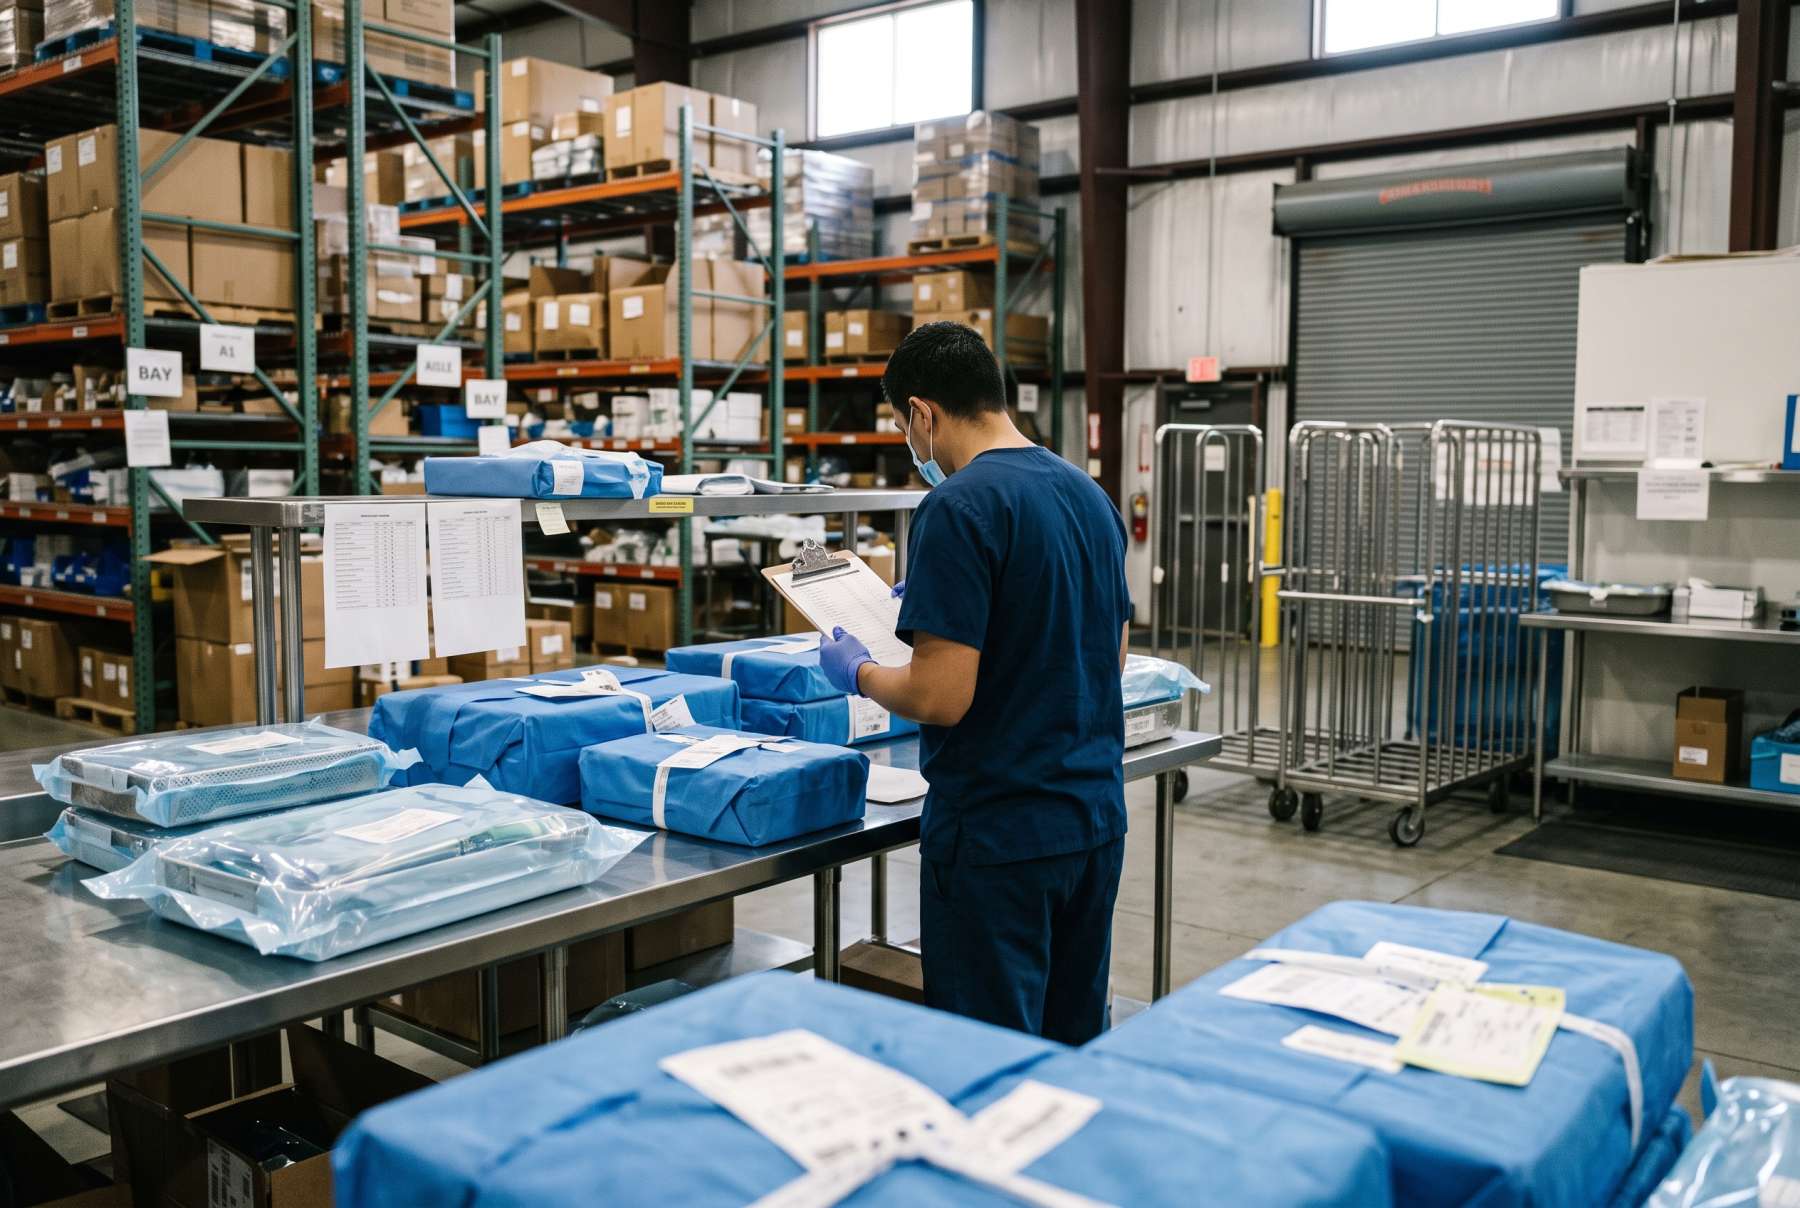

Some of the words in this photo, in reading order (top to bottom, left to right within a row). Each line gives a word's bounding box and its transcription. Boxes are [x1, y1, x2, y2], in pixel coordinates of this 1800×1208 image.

[219, 345, 235, 358] A1
[138, 365, 172, 381] BAY
[474, 393, 499, 405] BAY
